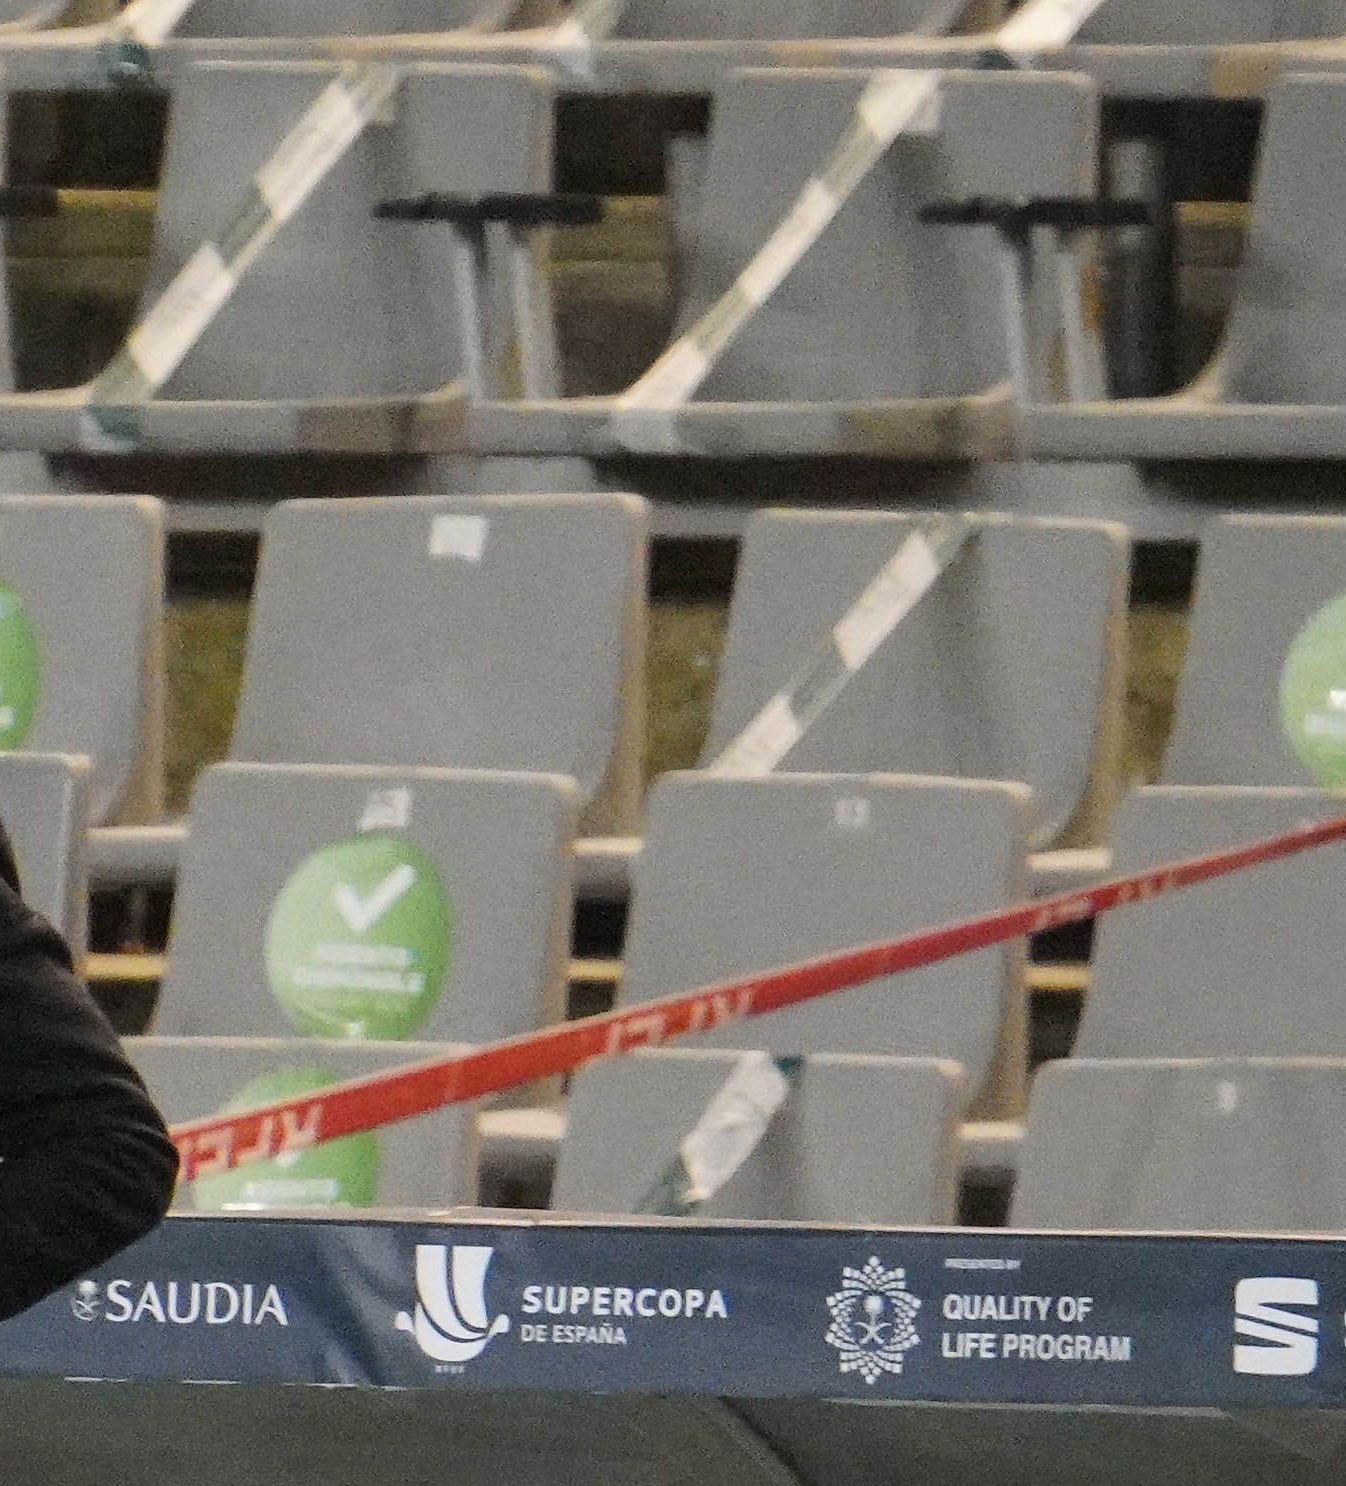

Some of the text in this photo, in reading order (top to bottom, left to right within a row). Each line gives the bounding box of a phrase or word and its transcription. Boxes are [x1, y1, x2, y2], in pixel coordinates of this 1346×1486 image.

[106, 1280, 290, 1327] SAUDIA
[520, 1285, 728, 1319] SUPERCOPA
[942, 1294, 1094, 1322] QUALITY OF
[520, 1320, 627, 1346] DE ESPAÑA
[941, 1333, 1132, 1361] LIFE PROGRAM
